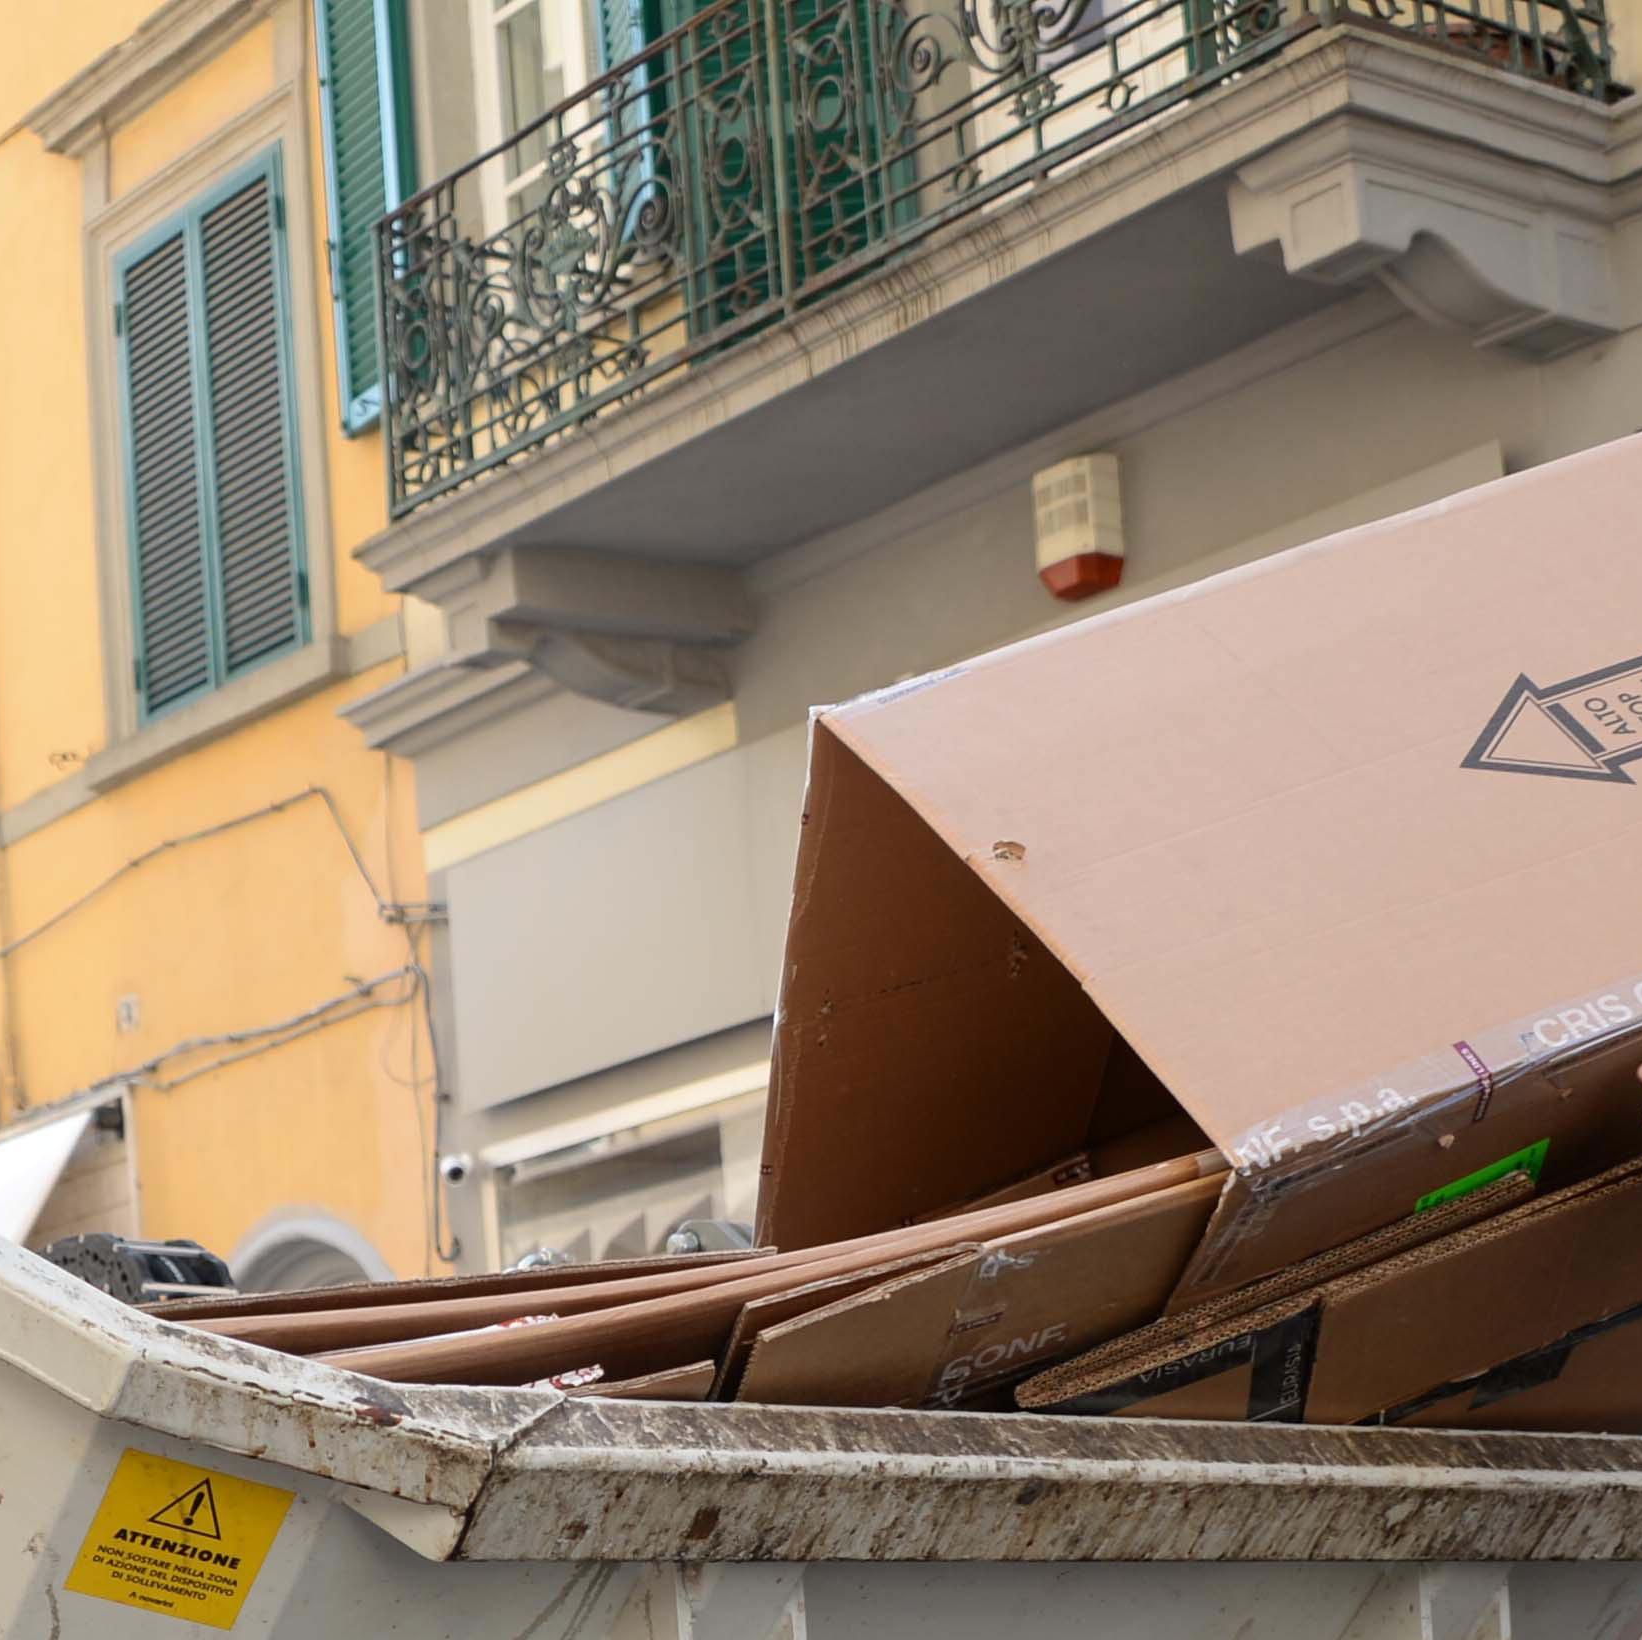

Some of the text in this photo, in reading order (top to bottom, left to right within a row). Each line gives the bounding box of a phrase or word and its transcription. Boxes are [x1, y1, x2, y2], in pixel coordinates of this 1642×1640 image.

[1584, 697, 1636, 736] ALTO
[1533, 994, 1633, 1048] CRIS
[1140, 1335, 1253, 1384] EURASIA
[97, 1545, 238, 1588] NON SOSTARE NELLA ZONA
[114, 1528, 241, 1570] ATTENZIONE
[92, 1555, 235, 1597] DI AZIONE DEL DISPOSITIVO
[111, 1570, 207, 1601] DI SOLLEVAMENTO
